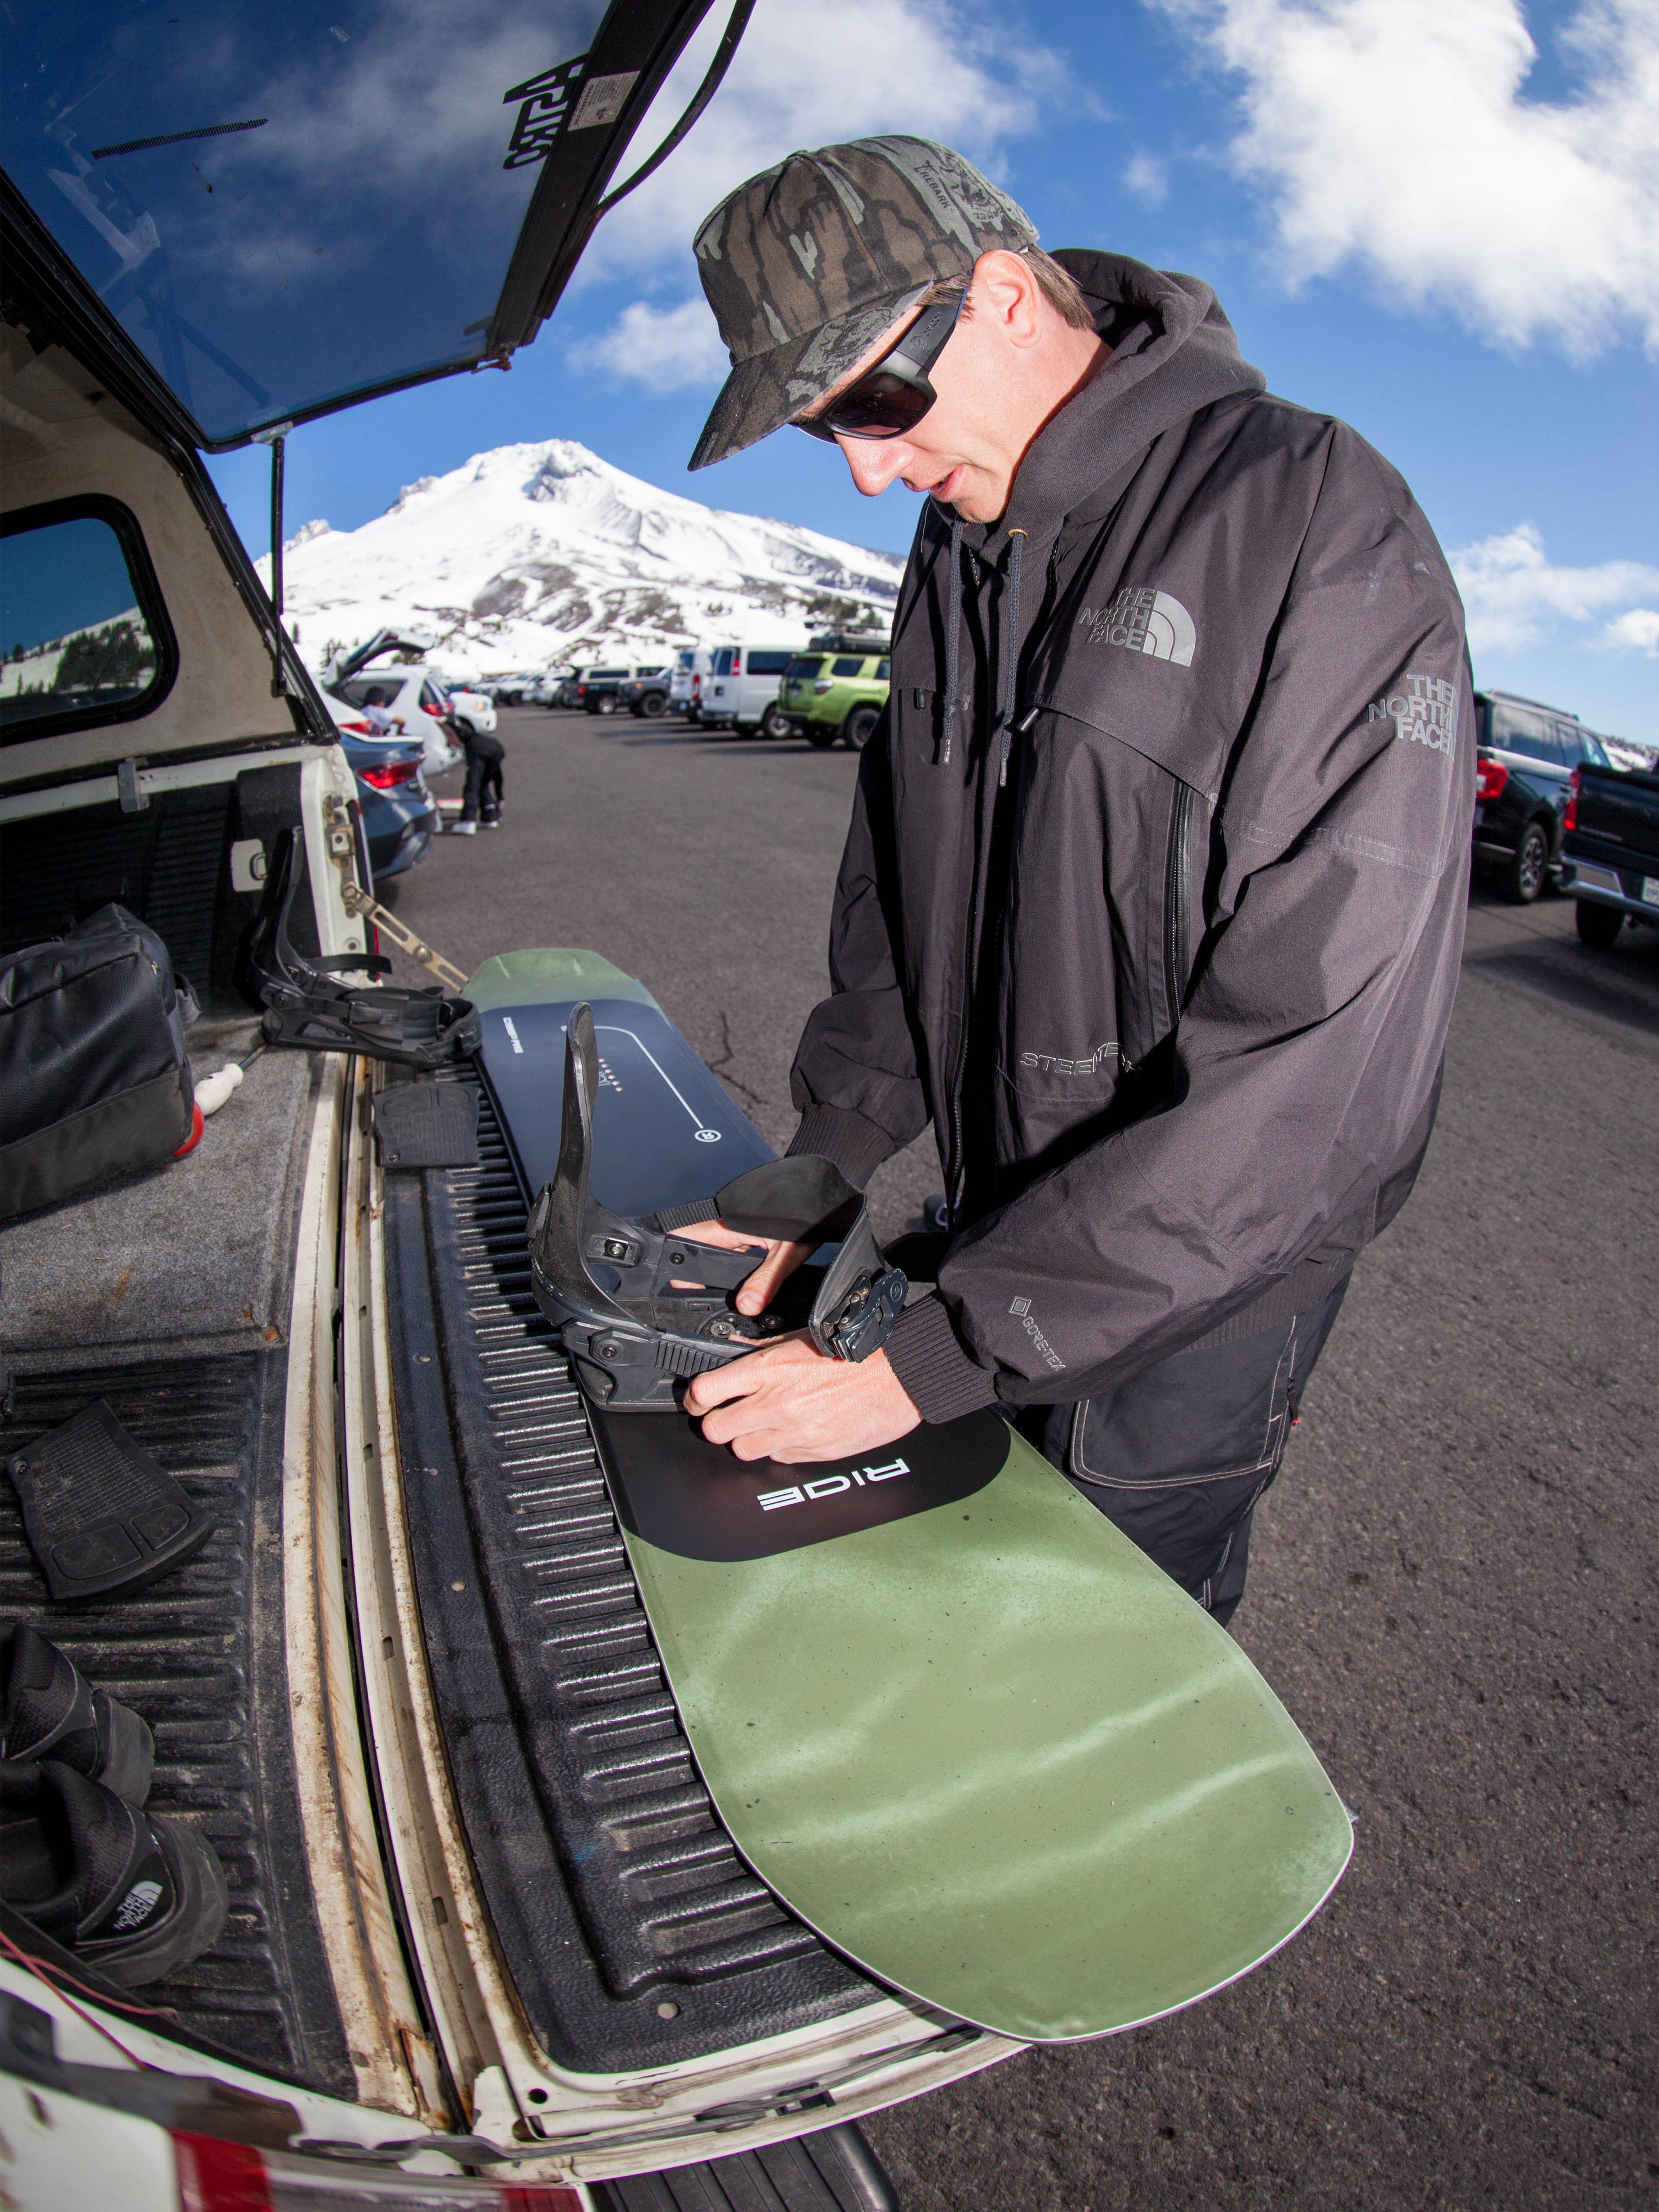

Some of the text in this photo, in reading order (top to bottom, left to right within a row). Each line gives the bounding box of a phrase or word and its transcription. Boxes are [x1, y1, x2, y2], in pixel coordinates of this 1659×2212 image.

[914, 160, 951, 208] TREBARK
[1115, 588, 1155, 609] THE
[1078, 606, 1150, 630] NORTH
[1087, 624, 1145, 651] FACE
[1406, 674, 1452, 707] THE
[1368, 695, 1452, 730] NORTH
[1397, 716, 1450, 754] FACE
[1022, 1316, 1066, 1372] GORE-TEX
[757, 1458, 910, 1512] RIDE
[113, 1897, 145, 1929] NORTH
